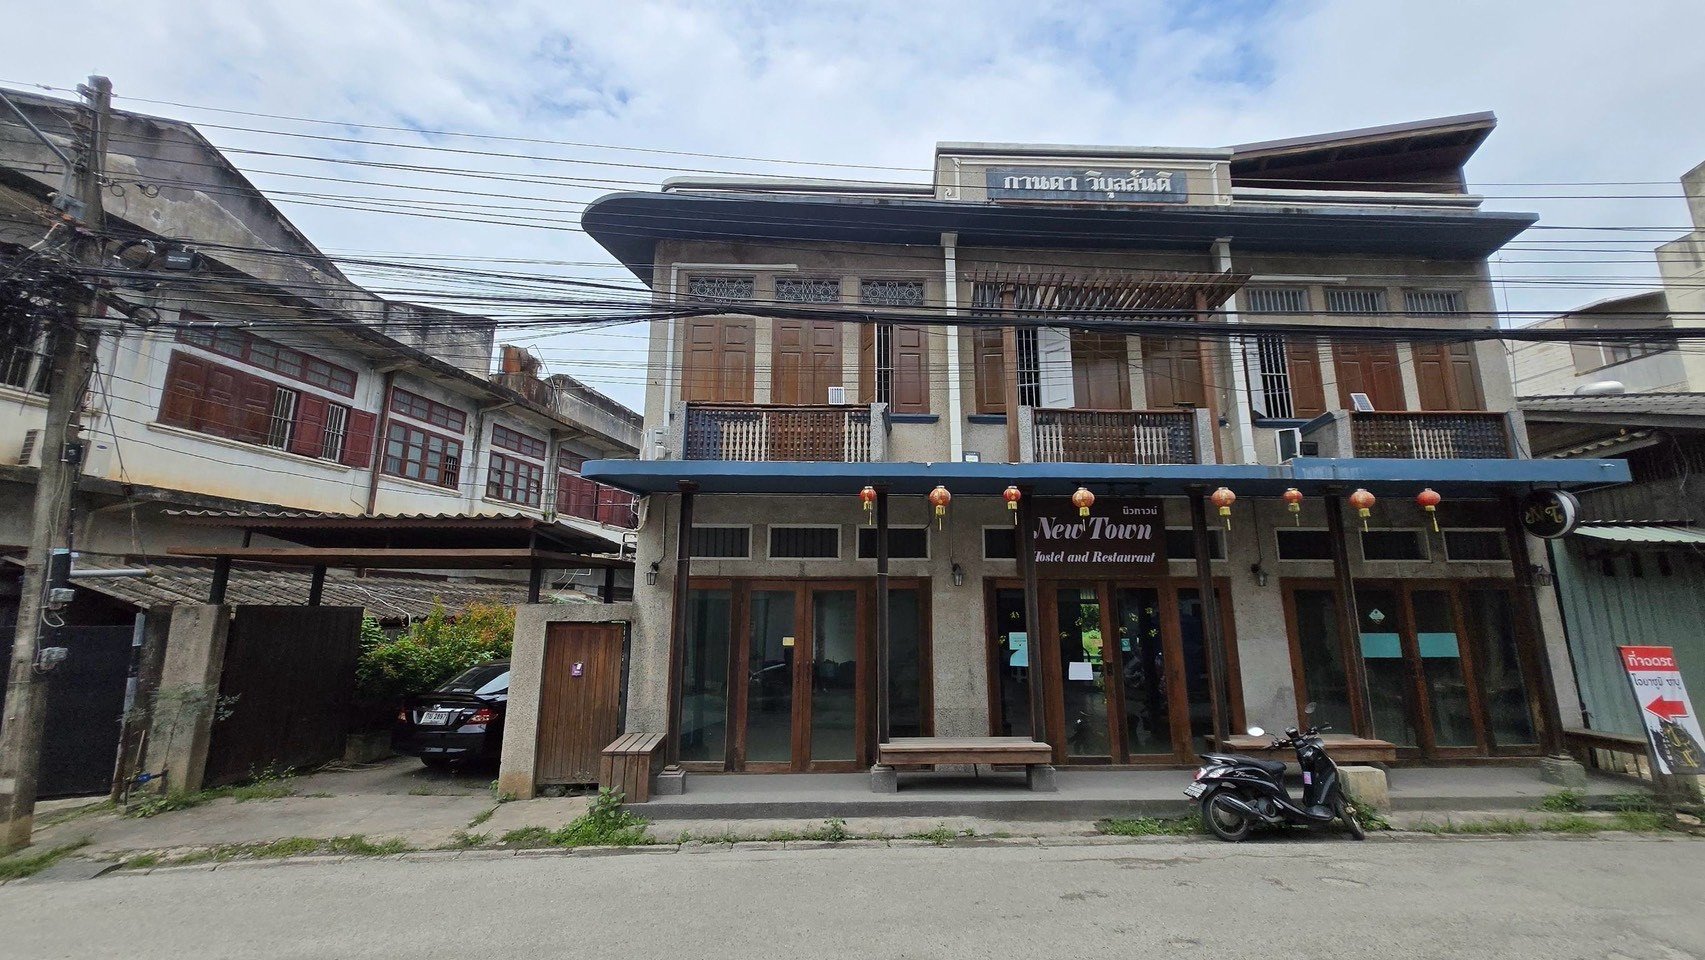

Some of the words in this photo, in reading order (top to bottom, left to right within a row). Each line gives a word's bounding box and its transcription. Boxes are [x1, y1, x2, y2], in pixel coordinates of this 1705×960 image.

[1004, 175, 1077, 191] กานดา
[1033, 516, 1084, 540] New
[1089, 516, 1153, 540] Town
[1067, 551, 1089, 563] and
[1092, 551, 1156, 564] Restaurant
